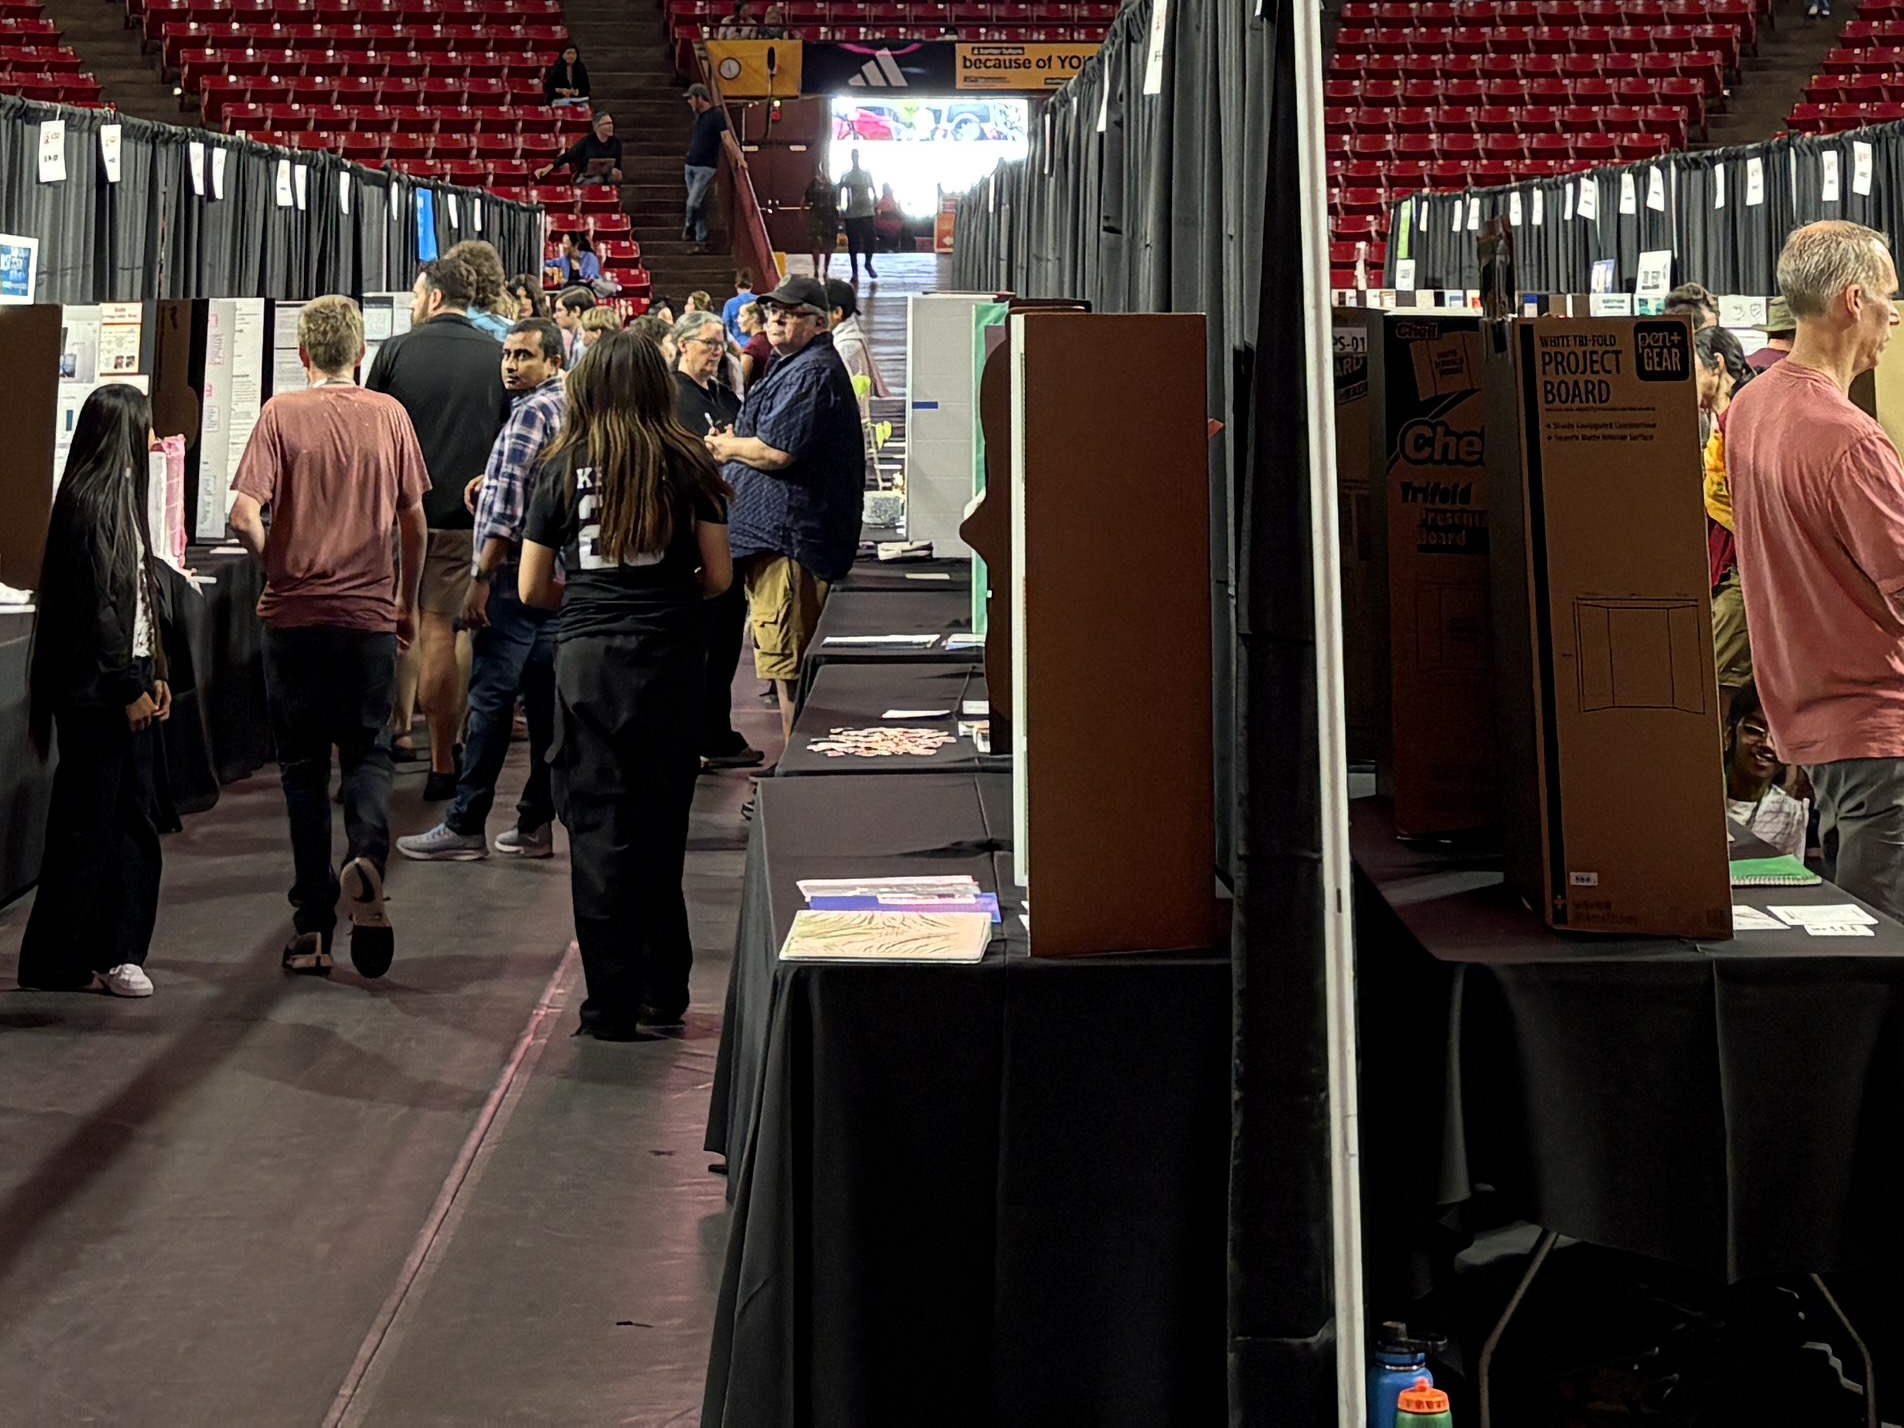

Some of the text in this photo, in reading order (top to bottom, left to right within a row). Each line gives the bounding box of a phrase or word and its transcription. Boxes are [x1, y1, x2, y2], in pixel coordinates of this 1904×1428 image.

[962, 55, 1032, 69] because
[1036, 55, 1053, 69] of
[1539, 334, 1617, 348] WHITE TRI-FOLD
[1542, 349, 1622, 375] PROJECT
[1644, 348, 1682, 372] GEAR
[1544, 379, 1611, 404] BOARD
